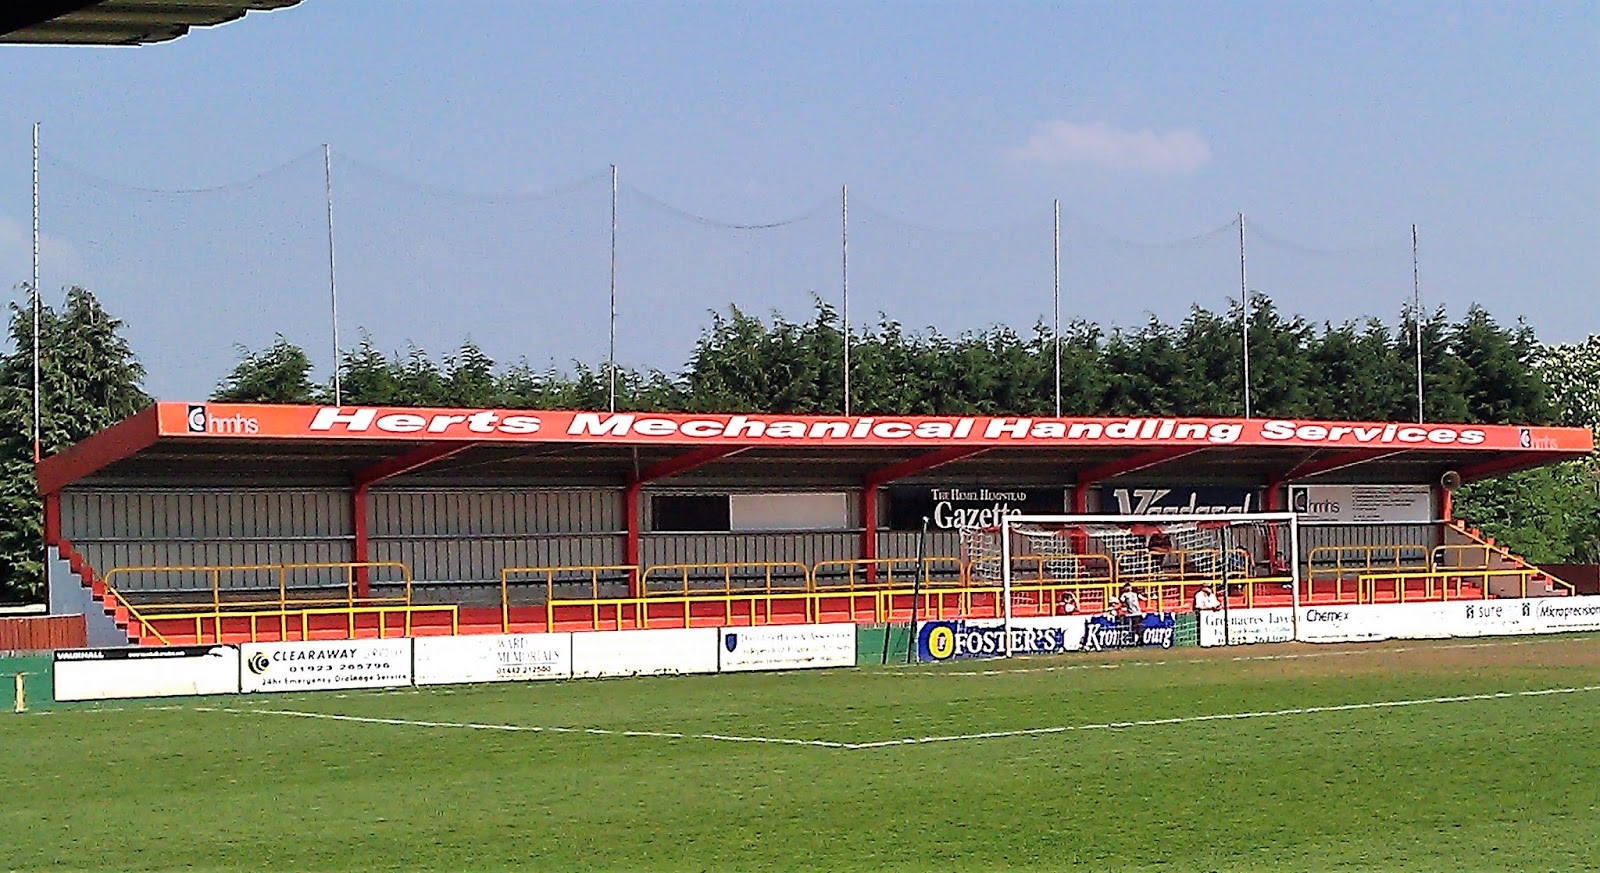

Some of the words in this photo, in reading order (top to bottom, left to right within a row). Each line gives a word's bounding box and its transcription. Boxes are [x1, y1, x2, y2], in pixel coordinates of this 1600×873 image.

[208, 413, 259, 434] hmhs
[308, 407, 542, 434] Herts
[567, 412, 975, 439] Mechanical
[983, 417, 1244, 443] Handling
[1260, 420, 1486, 444] Services
[934, 500, 1022, 529] Gazette
[1306, 609, 1349, 622] Chemex
[1479, 605, 1502, 617] sure
[1540, 604, 1600, 619] Microprecision
[1205, 614, 1263, 626] Grenacres
[954, 629, 1056, 655] FOSTER'S
[56, 651, 104, 660] VAUXHALL
[273, 648, 357, 662] CLEARAWAY
[335, 674, 373, 683] Drainage
[376, 673, 407, 681] Service
